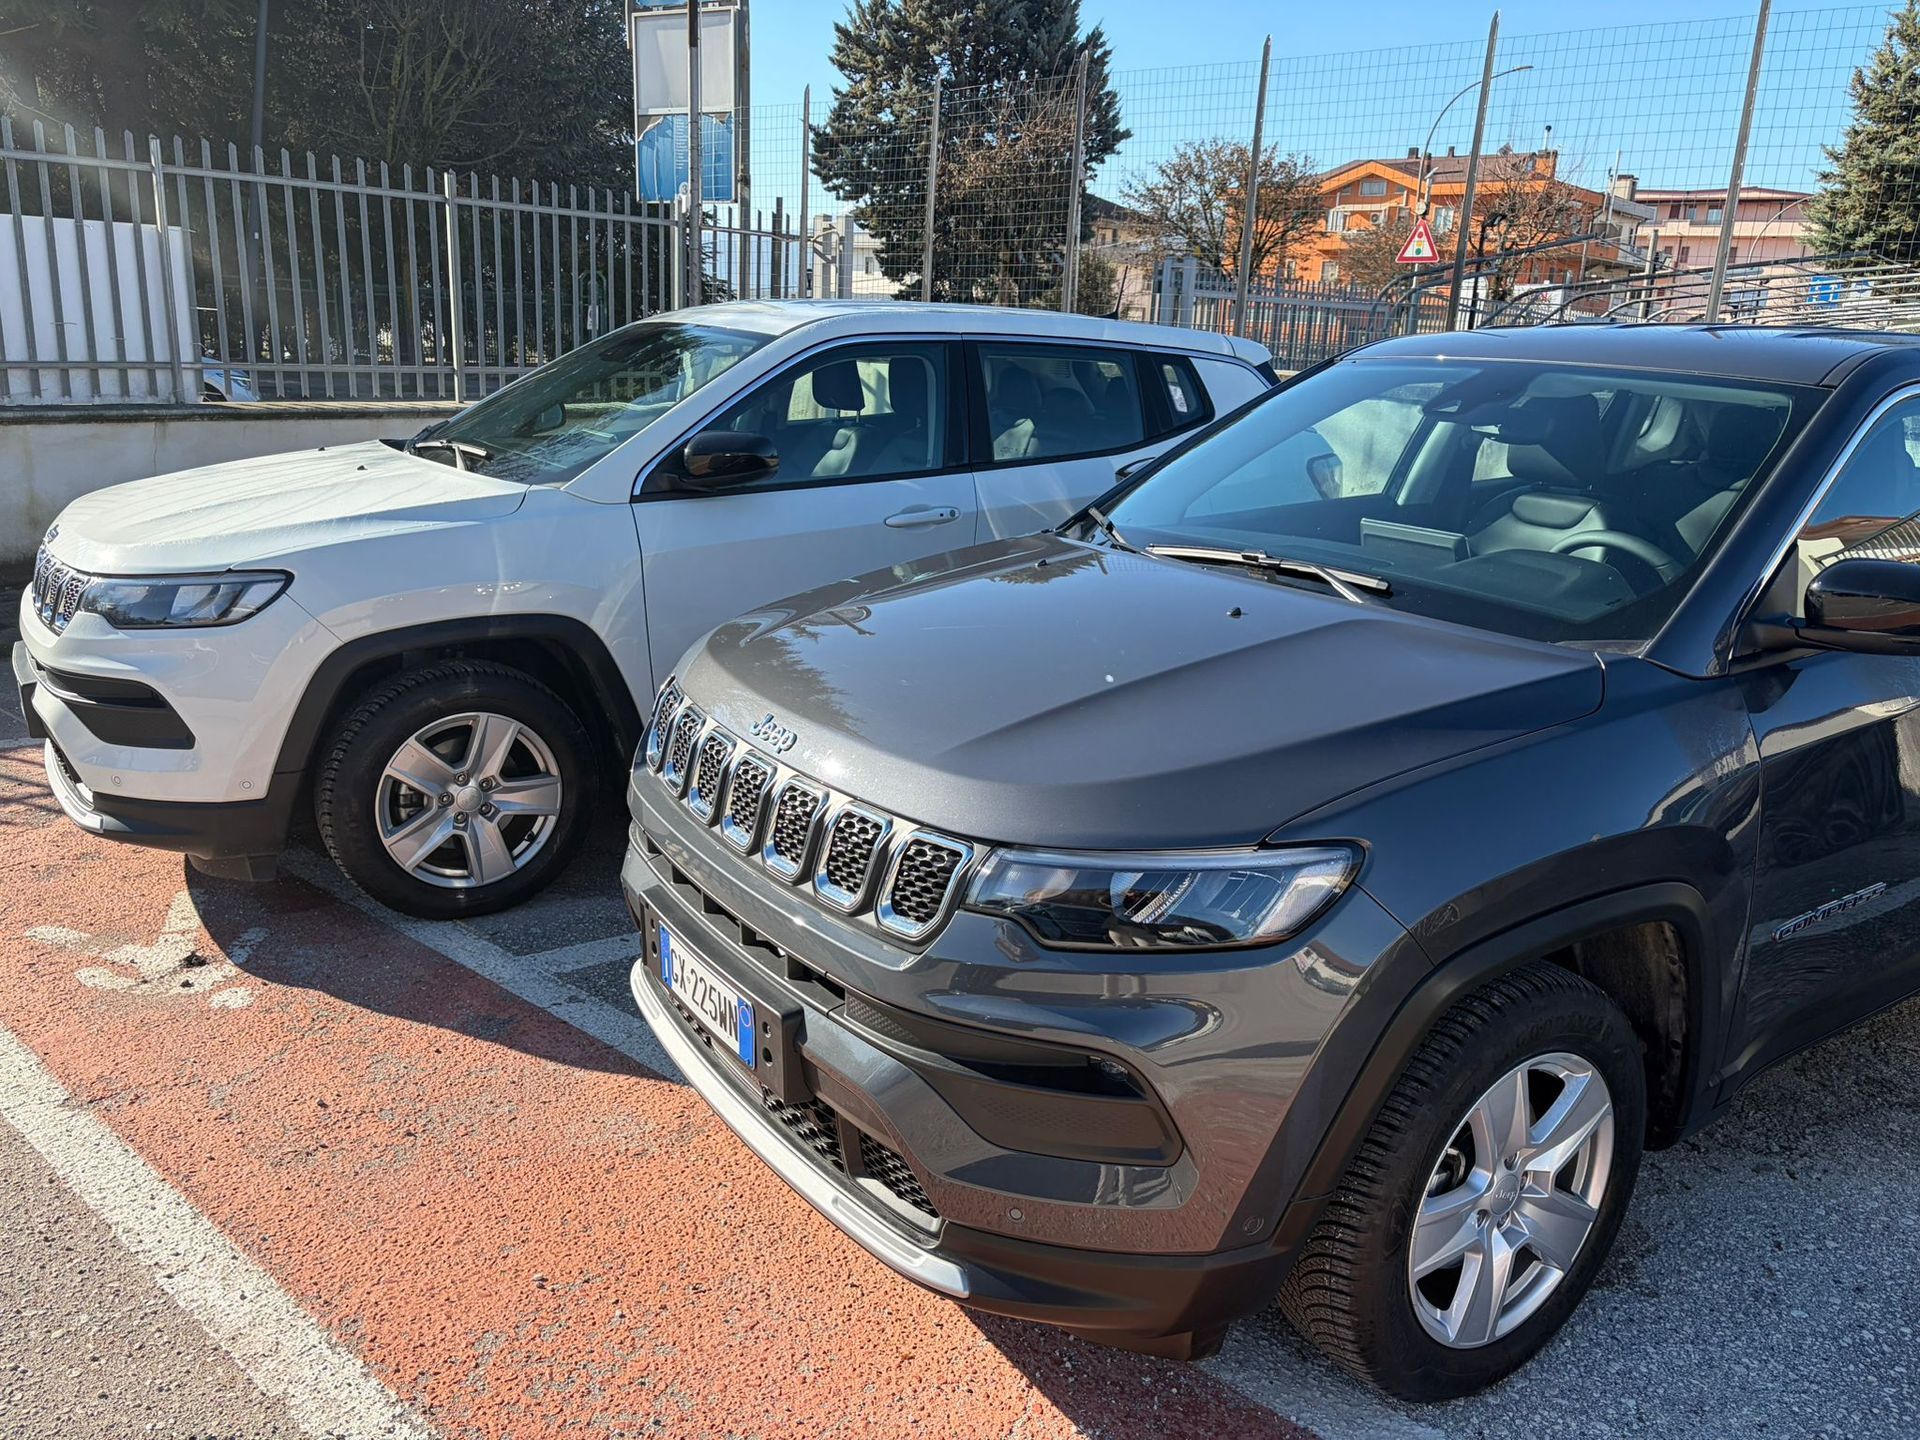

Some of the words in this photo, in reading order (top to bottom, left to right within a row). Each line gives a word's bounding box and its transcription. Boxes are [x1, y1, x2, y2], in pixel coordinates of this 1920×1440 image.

[750, 712, 798, 754] Jeep
[1771, 882, 1887, 942] COMPASS
[1495, 1189, 1516, 1202] Jeep
